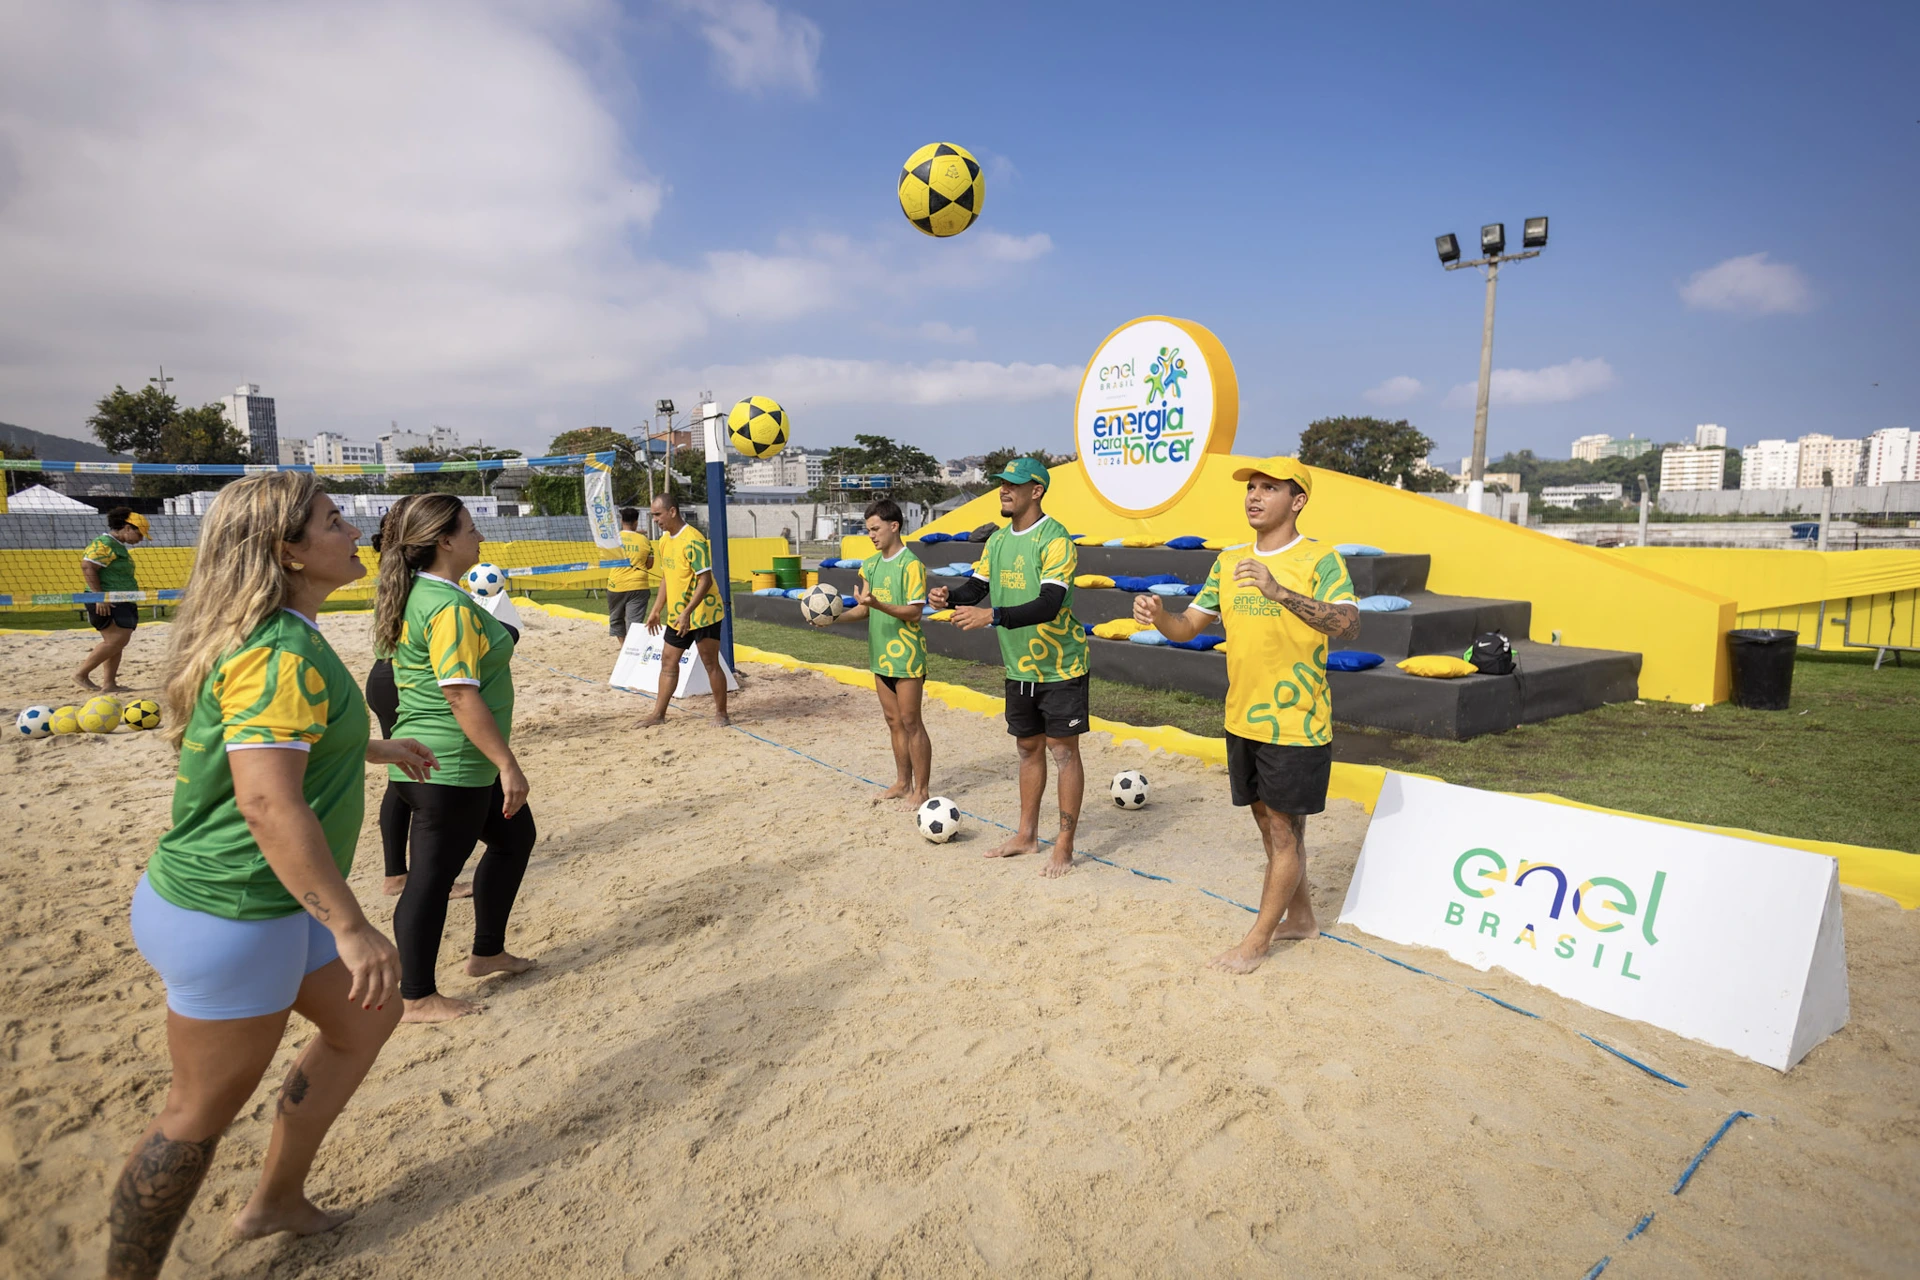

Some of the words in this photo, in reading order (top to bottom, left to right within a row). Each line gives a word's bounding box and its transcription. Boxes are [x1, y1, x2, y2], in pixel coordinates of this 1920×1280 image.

[1099, 357, 1135, 381] enel
[1100, 379, 1134, 391] BRASIL
[1093, 400, 1184, 440] energia
[1093, 437, 1122, 455] para
[1122, 437, 1194, 466] torcer
[1097, 457, 1121, 466] 2026
[592, 496, 609, 540] energia
[1233, 604, 1249, 613] para
[1249, 605, 1282, 617] torcer
[1453, 848, 1667, 946] enel
[1445, 901, 1642, 981] BRASIL
